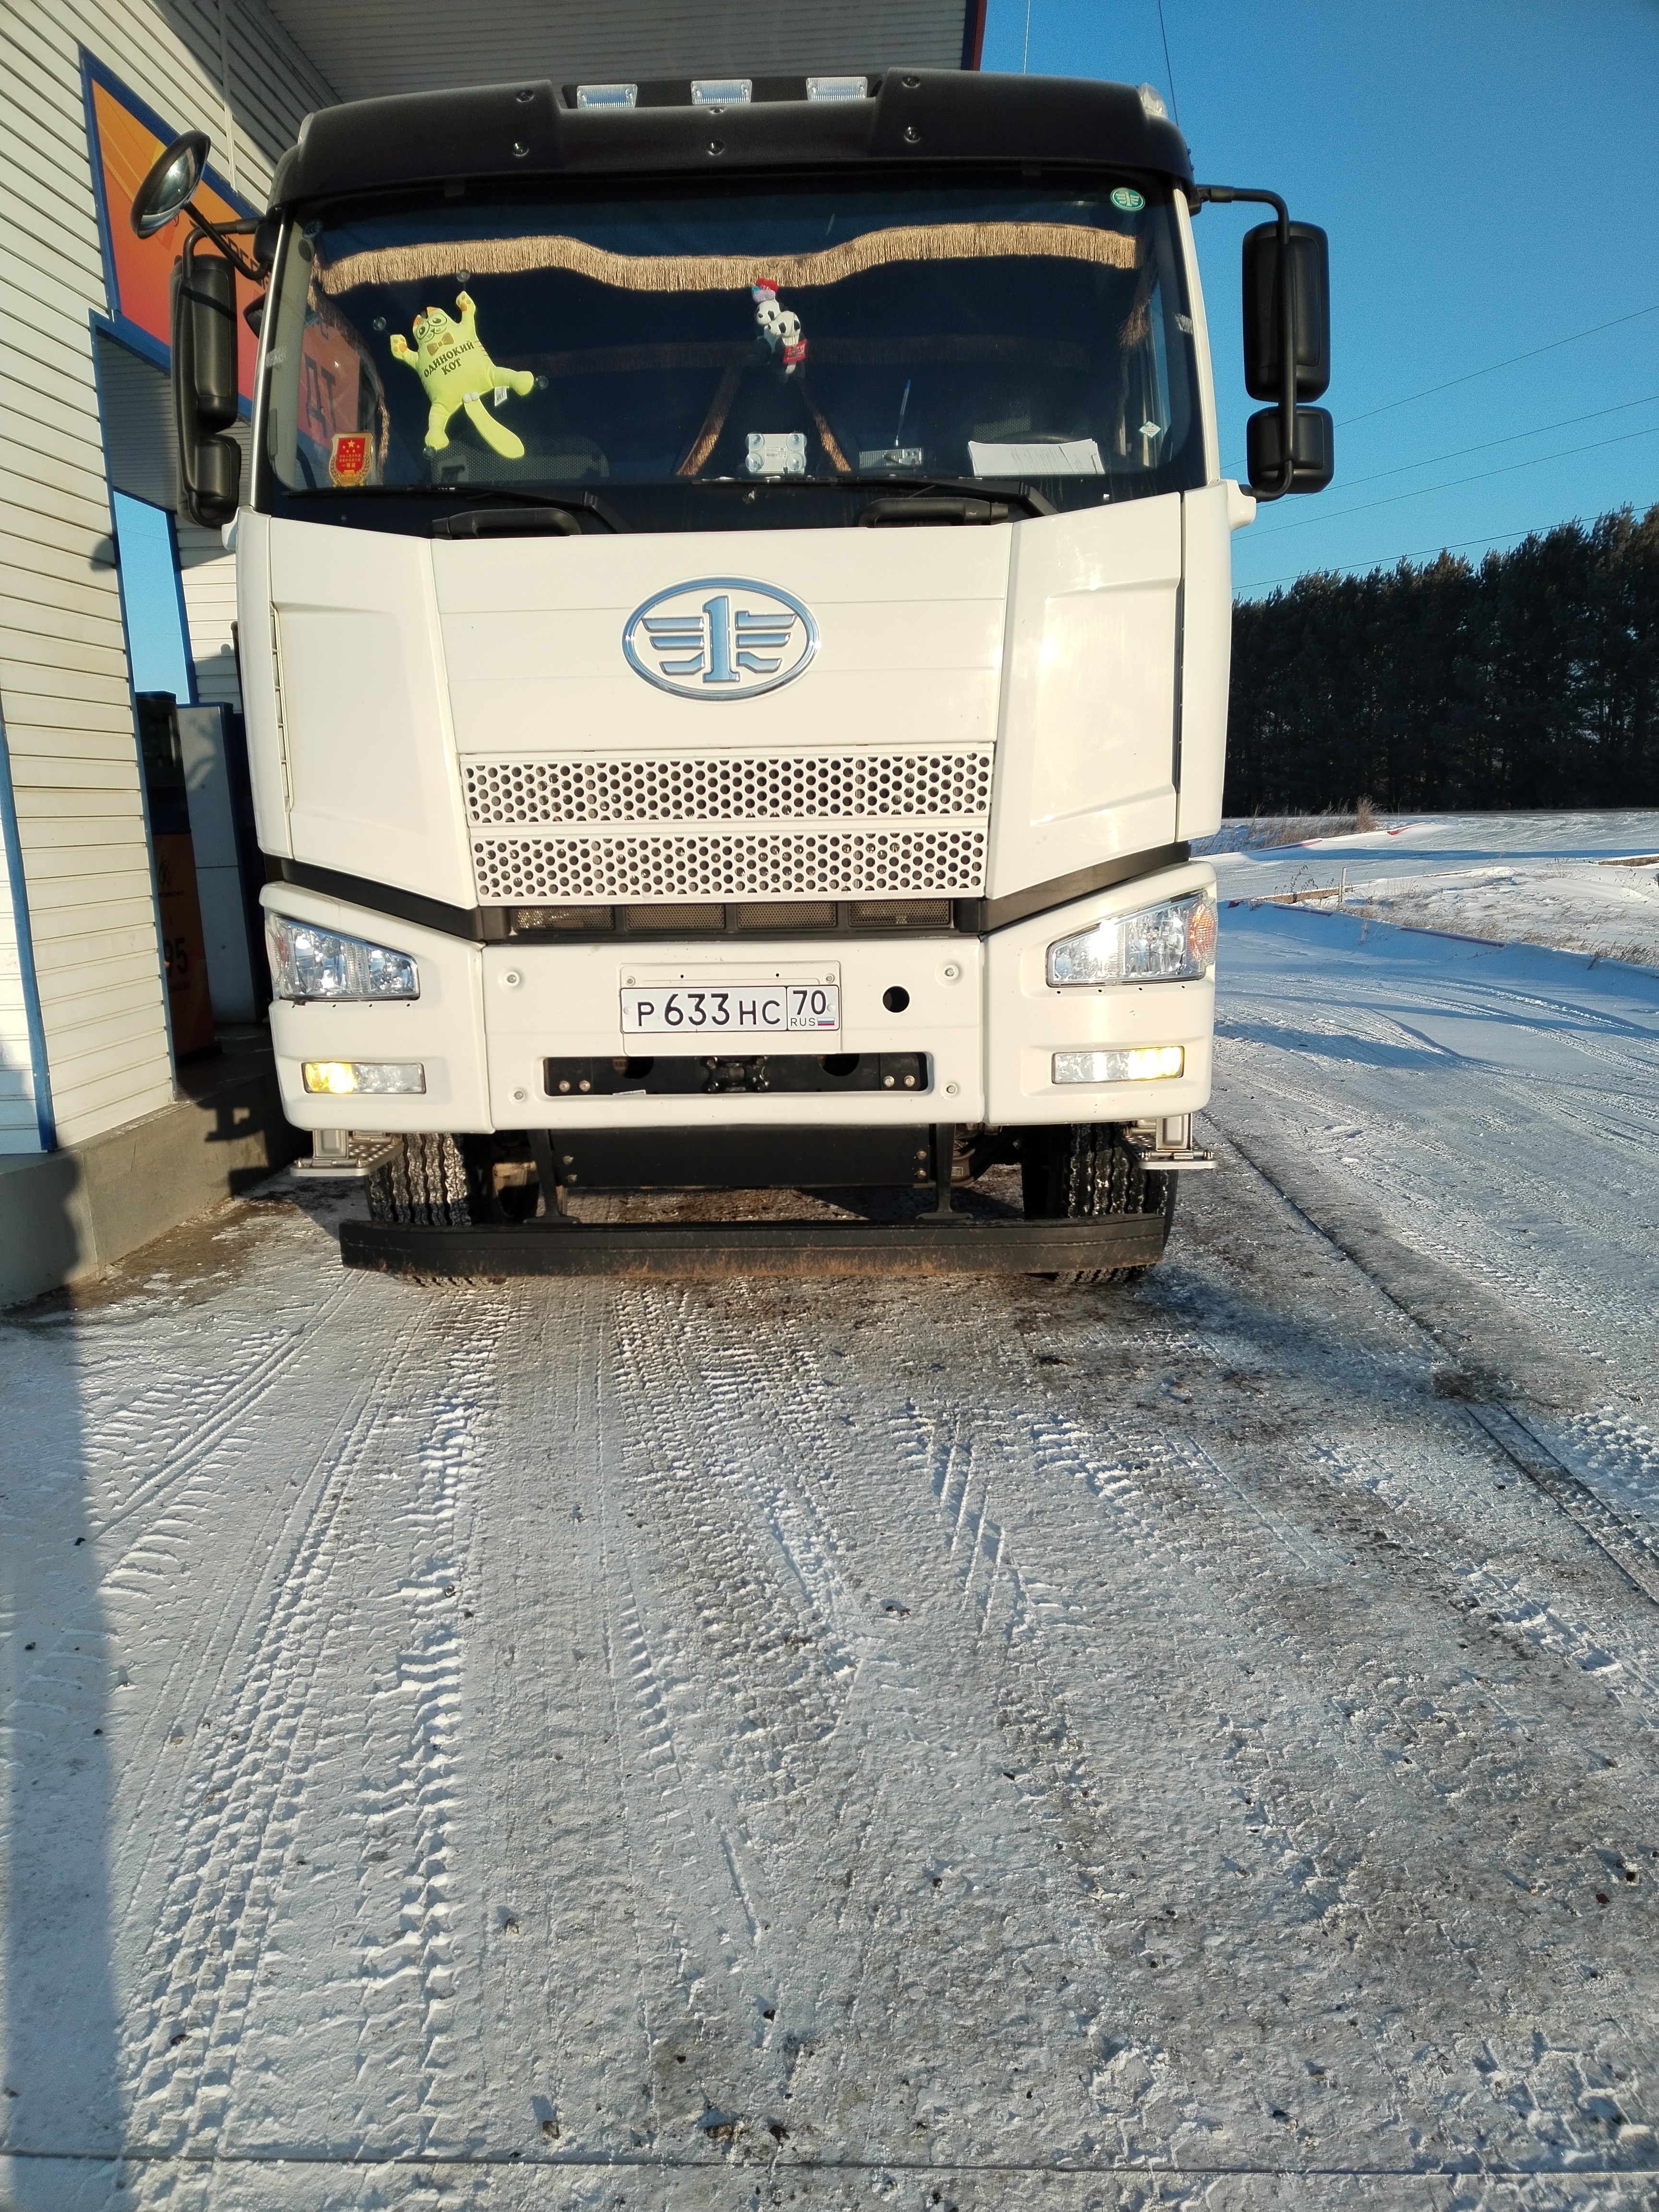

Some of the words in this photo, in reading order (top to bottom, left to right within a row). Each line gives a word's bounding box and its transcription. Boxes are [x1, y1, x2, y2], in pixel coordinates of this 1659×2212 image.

[424, 340, 475, 377] ОДИНОКИЙ
[441, 358, 461, 375] КОТ
[793, 990, 826, 1015] 70
[791, 1017, 815, 1026] RUS
